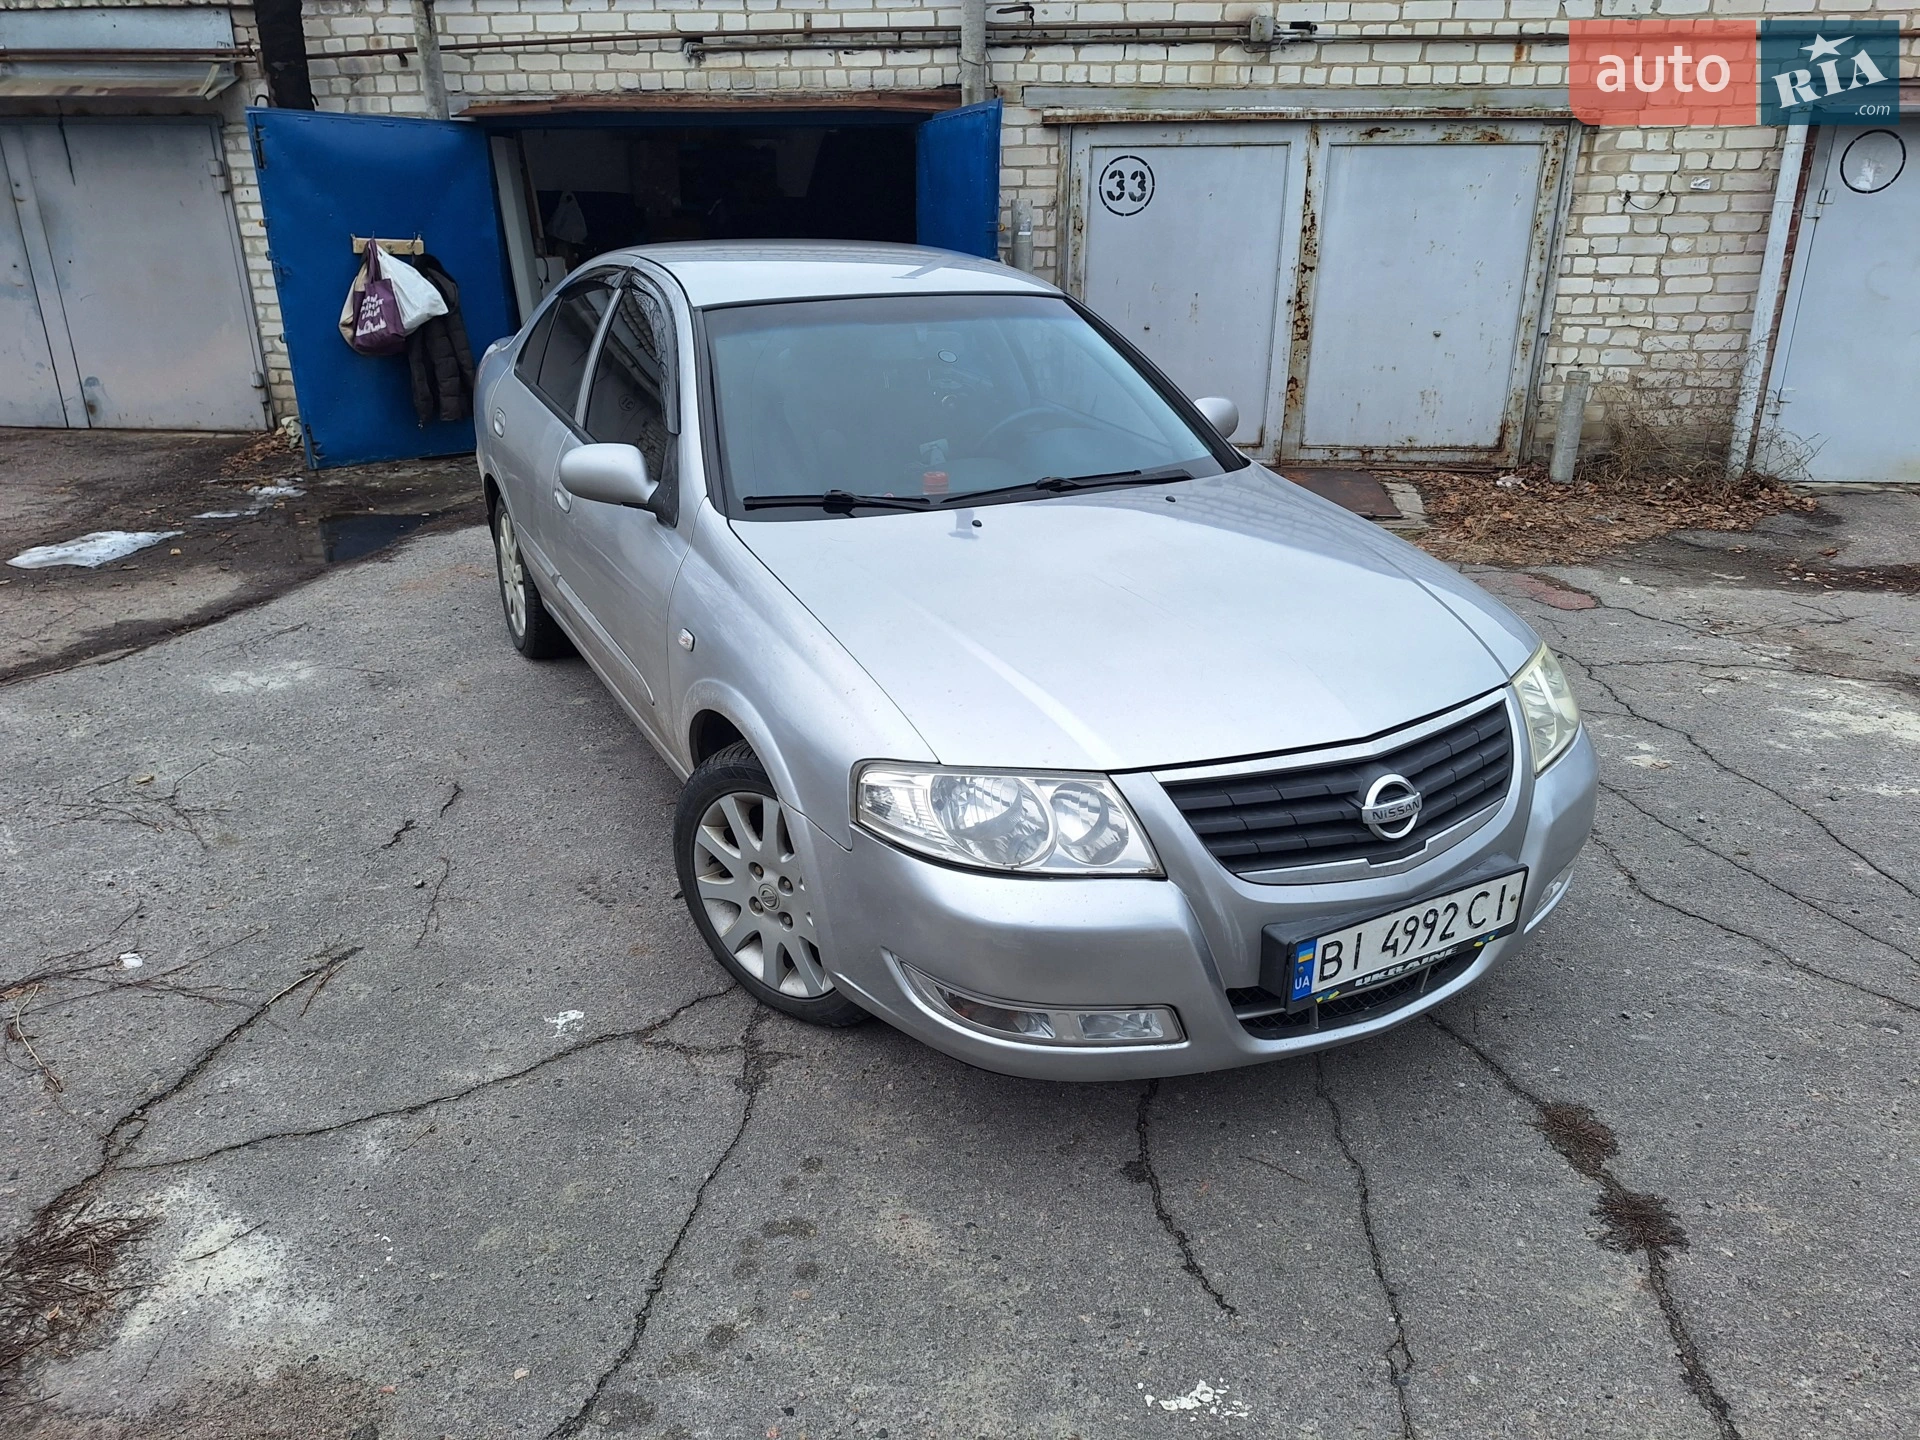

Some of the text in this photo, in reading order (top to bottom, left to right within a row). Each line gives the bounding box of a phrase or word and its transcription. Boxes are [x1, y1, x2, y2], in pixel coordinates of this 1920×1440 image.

[1106, 169, 1147, 202] 33
[1372, 800, 1420, 820] NISSAN
[1318, 884, 1508, 982] BI 4992 CI
[1294, 976, 1311, 991] UA
